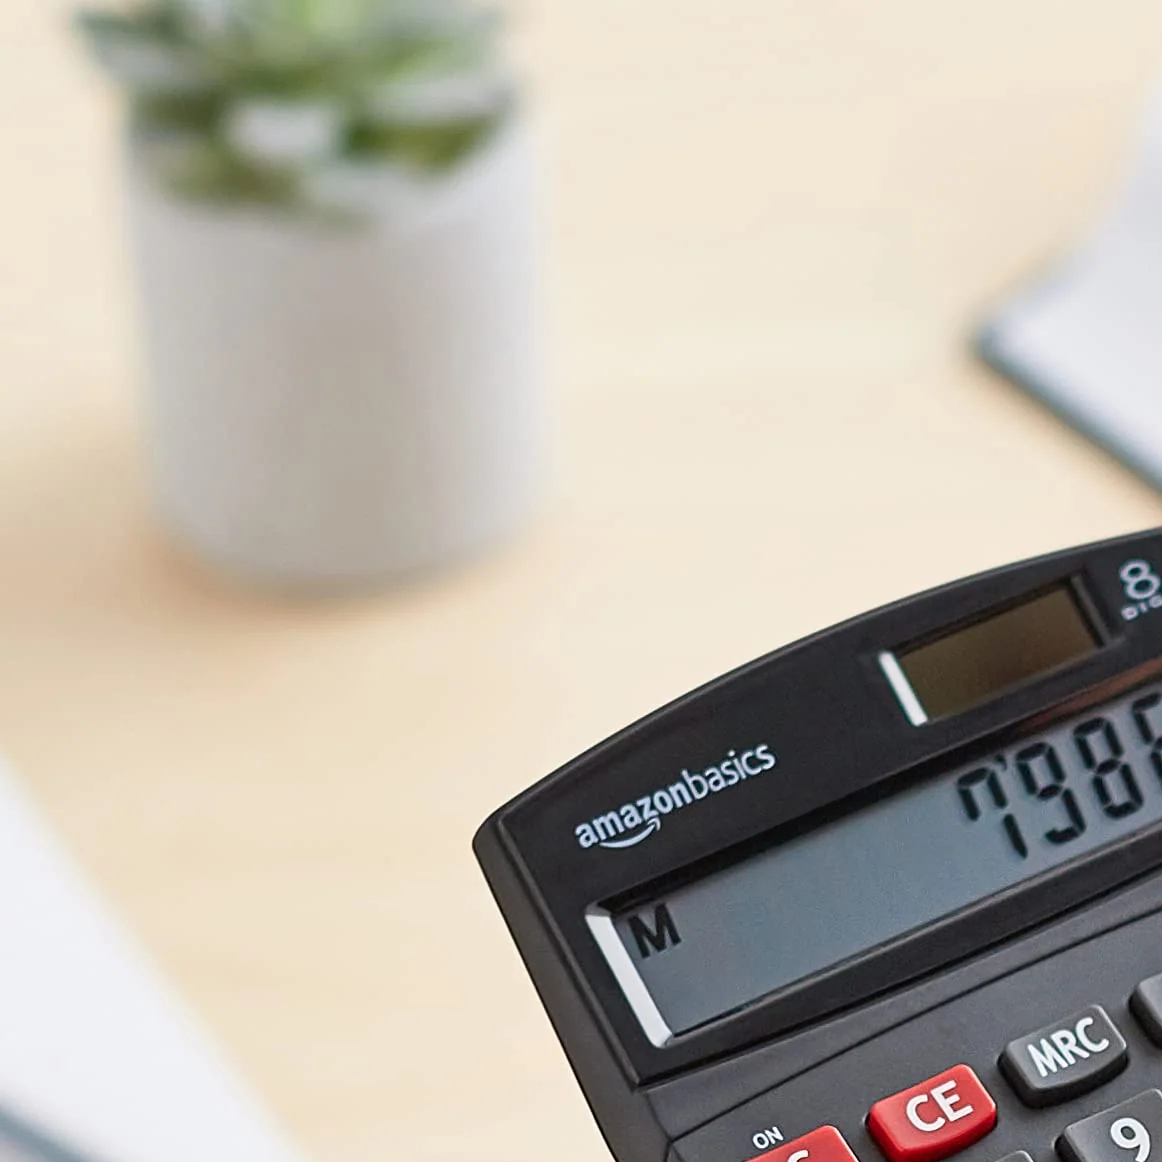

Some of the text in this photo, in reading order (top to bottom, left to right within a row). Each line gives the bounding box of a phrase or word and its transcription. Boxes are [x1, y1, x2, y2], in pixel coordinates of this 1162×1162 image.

[1120, 560, 1162, 600] 8
[574, 740, 776, 848] amazonbasics
[629, 901, 682, 957] M
[1027, 1014, 1111, 1078] MRC
[906, 1079, 974, 1132] CE
[752, 1126, 784, 1149] ON
